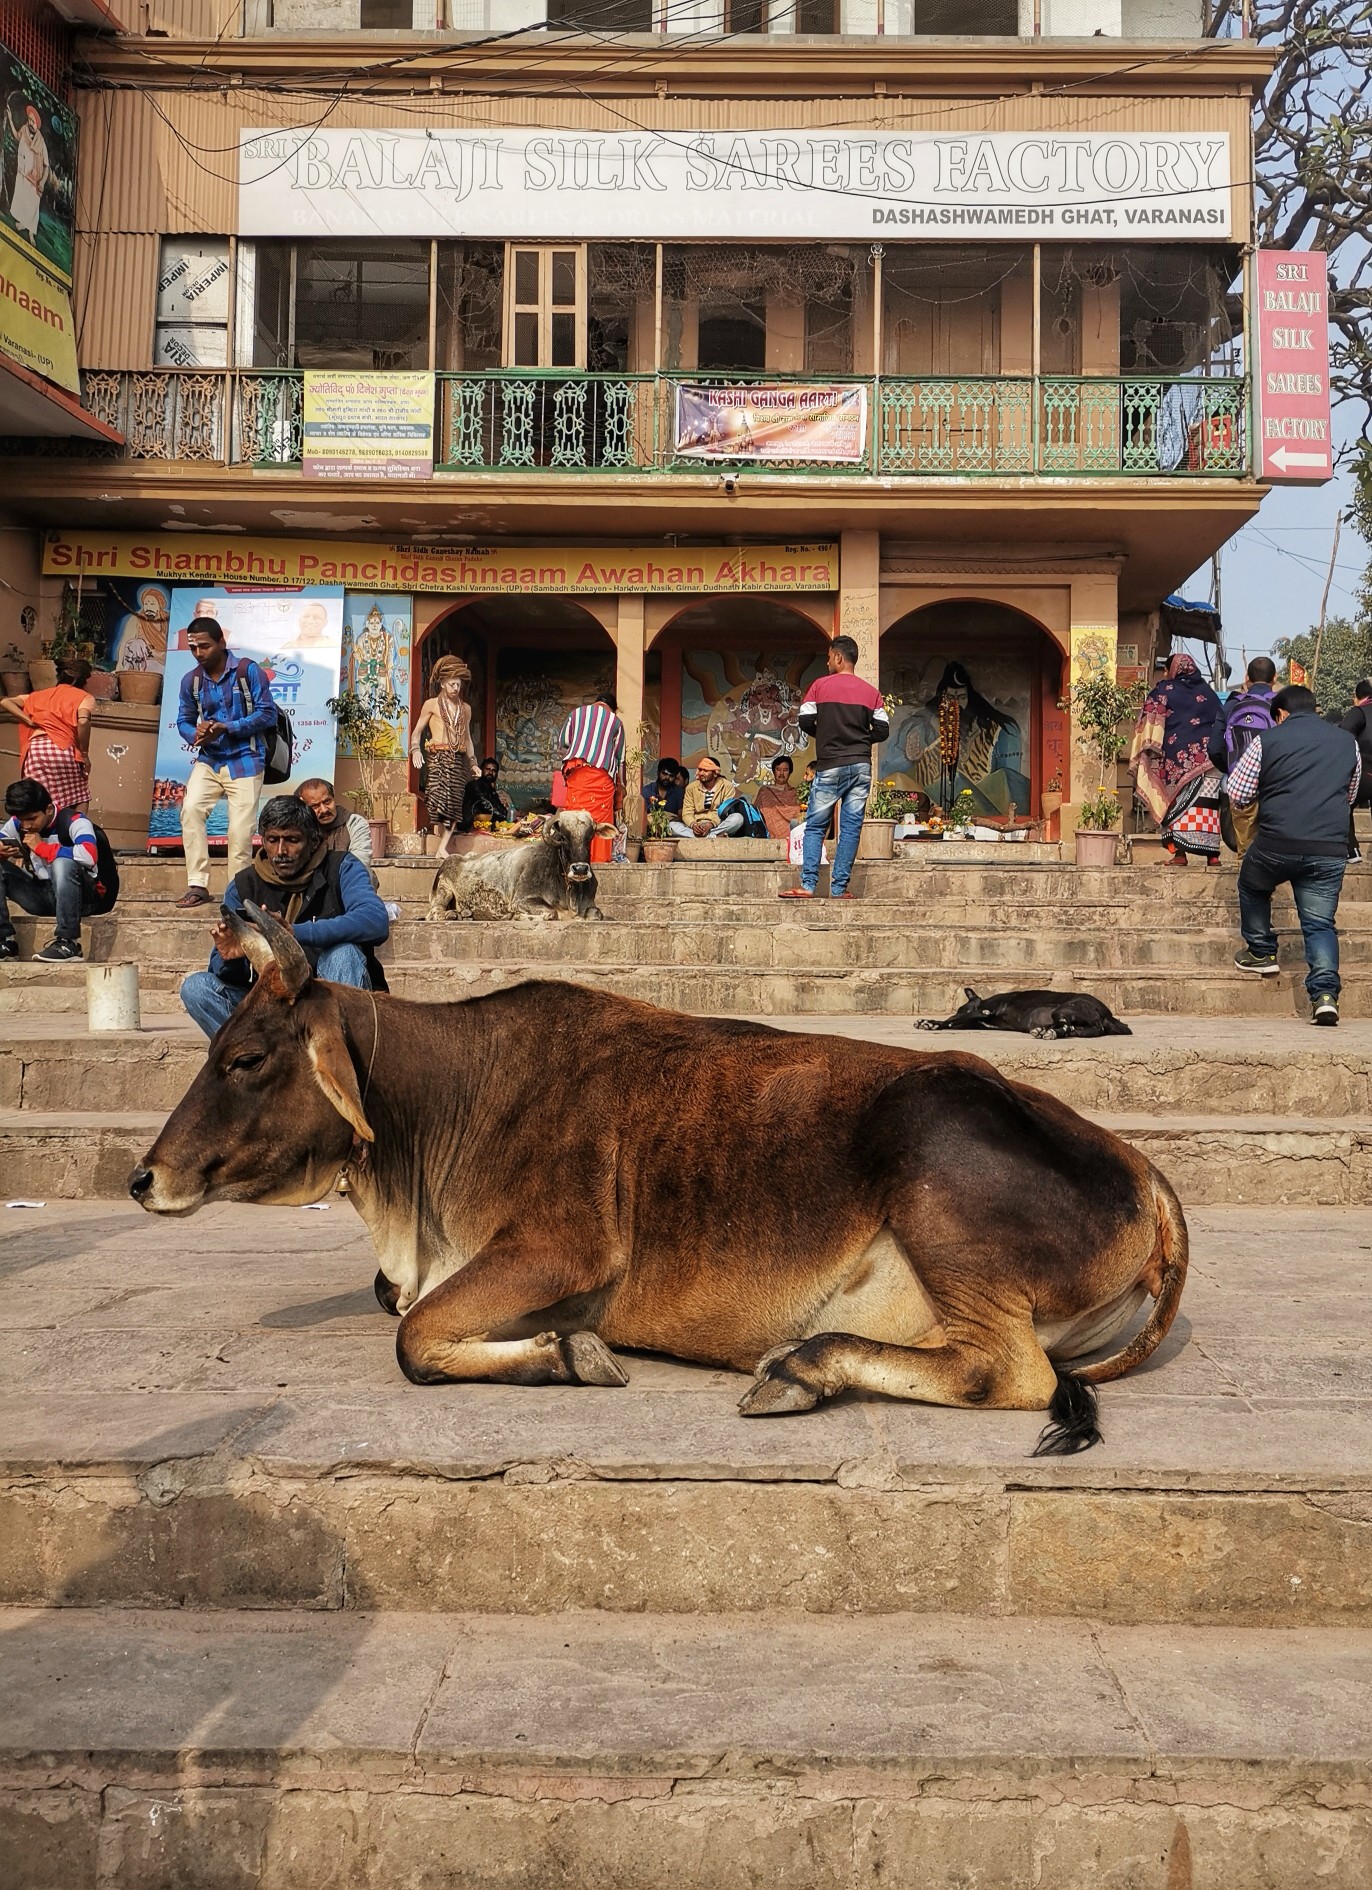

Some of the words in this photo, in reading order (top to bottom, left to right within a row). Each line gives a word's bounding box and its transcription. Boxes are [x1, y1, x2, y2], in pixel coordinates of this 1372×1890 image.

[244, 138, 287, 159] SRI
[291, 138, 503, 202] BALAJI
[524, 138, 667, 191] SILK
[686, 138, 915, 191] SAREES
[934, 140, 1224, 192] FACTORY
[872, 209, 1054, 224] DASHASHWAMEDH
[1062, 209, 1118, 227] GHAT,
[1125, 209, 1224, 224] VARANASI
[1277, 263, 1308, 280] SRI
[1264, 290, 1321, 317] BALAJI
[170, 337, 190, 359] DECOR
[1273, 328, 1314, 350] SILK
[38, 354, 53, 370] (UP)
[164, 341, 192, 366] RIA
[1267, 372, 1322, 395] SAREES
[708, 390, 747, 409] KASHI
[750, 390, 796, 411] GANGA
[800, 390, 837, 410] AARTI
[1264, 417, 1328, 440] FACTORY
[413, 546, 428, 554] Sidh
[785, 546, 798, 554] Reg.
[51, 544, 117, 567] Shri
[130, 546, 286, 575] Shambhu
[300, 554, 565, 584] Panchdashnaam
[576, 563, 704, 584] Awahan
[714, 561, 829, 582] Akhara
[157, 571, 186, 579] Mukhya
[380, 582, 400, 590] Ghat,
[506, 585, 522, 593] (UP)
